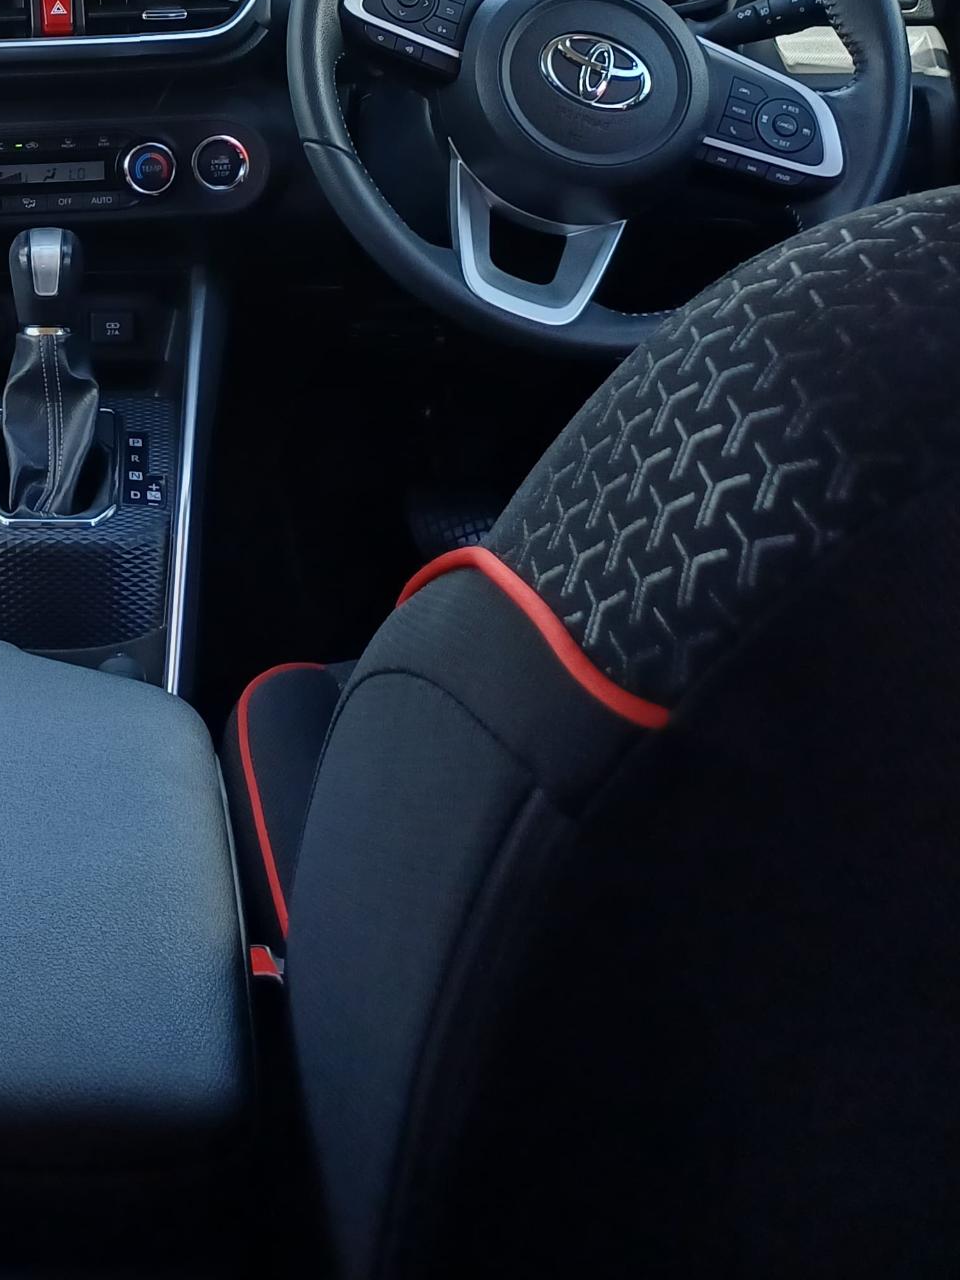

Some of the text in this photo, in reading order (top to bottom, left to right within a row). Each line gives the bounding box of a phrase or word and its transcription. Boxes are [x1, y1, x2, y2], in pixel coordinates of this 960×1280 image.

[58, 198, 72, 206] OFF
[91, 196, 113, 204] AUTO
[131, 454, 140, 463] R
[130, 490, 141, 499] D
